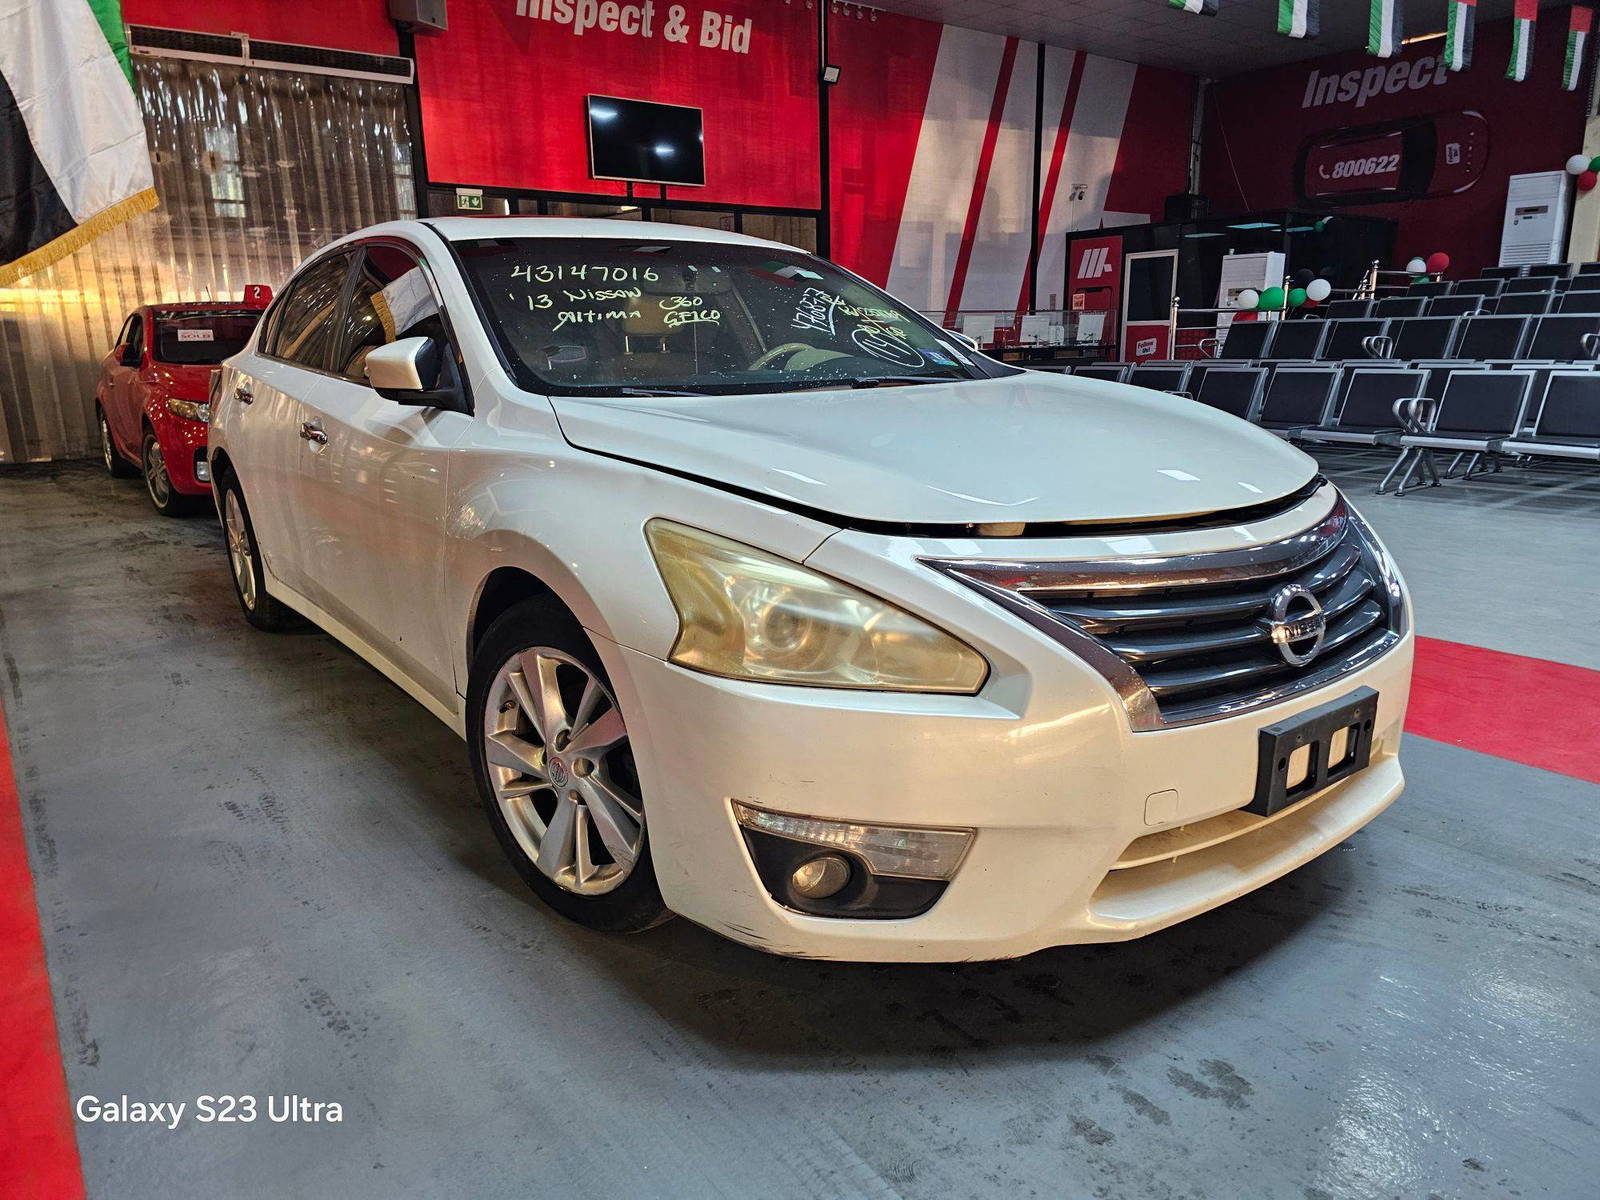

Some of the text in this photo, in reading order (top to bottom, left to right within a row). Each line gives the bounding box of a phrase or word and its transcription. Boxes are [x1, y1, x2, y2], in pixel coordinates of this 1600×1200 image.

[663, 5, 690, 44] &
[700, 10, 752, 54] Bid
[1301, 55, 1448, 108] Inspect
[1332, 154, 1400, 179] 800622
[511, 264, 659, 283] 43147016
[254, 286, 261, 299] 2
